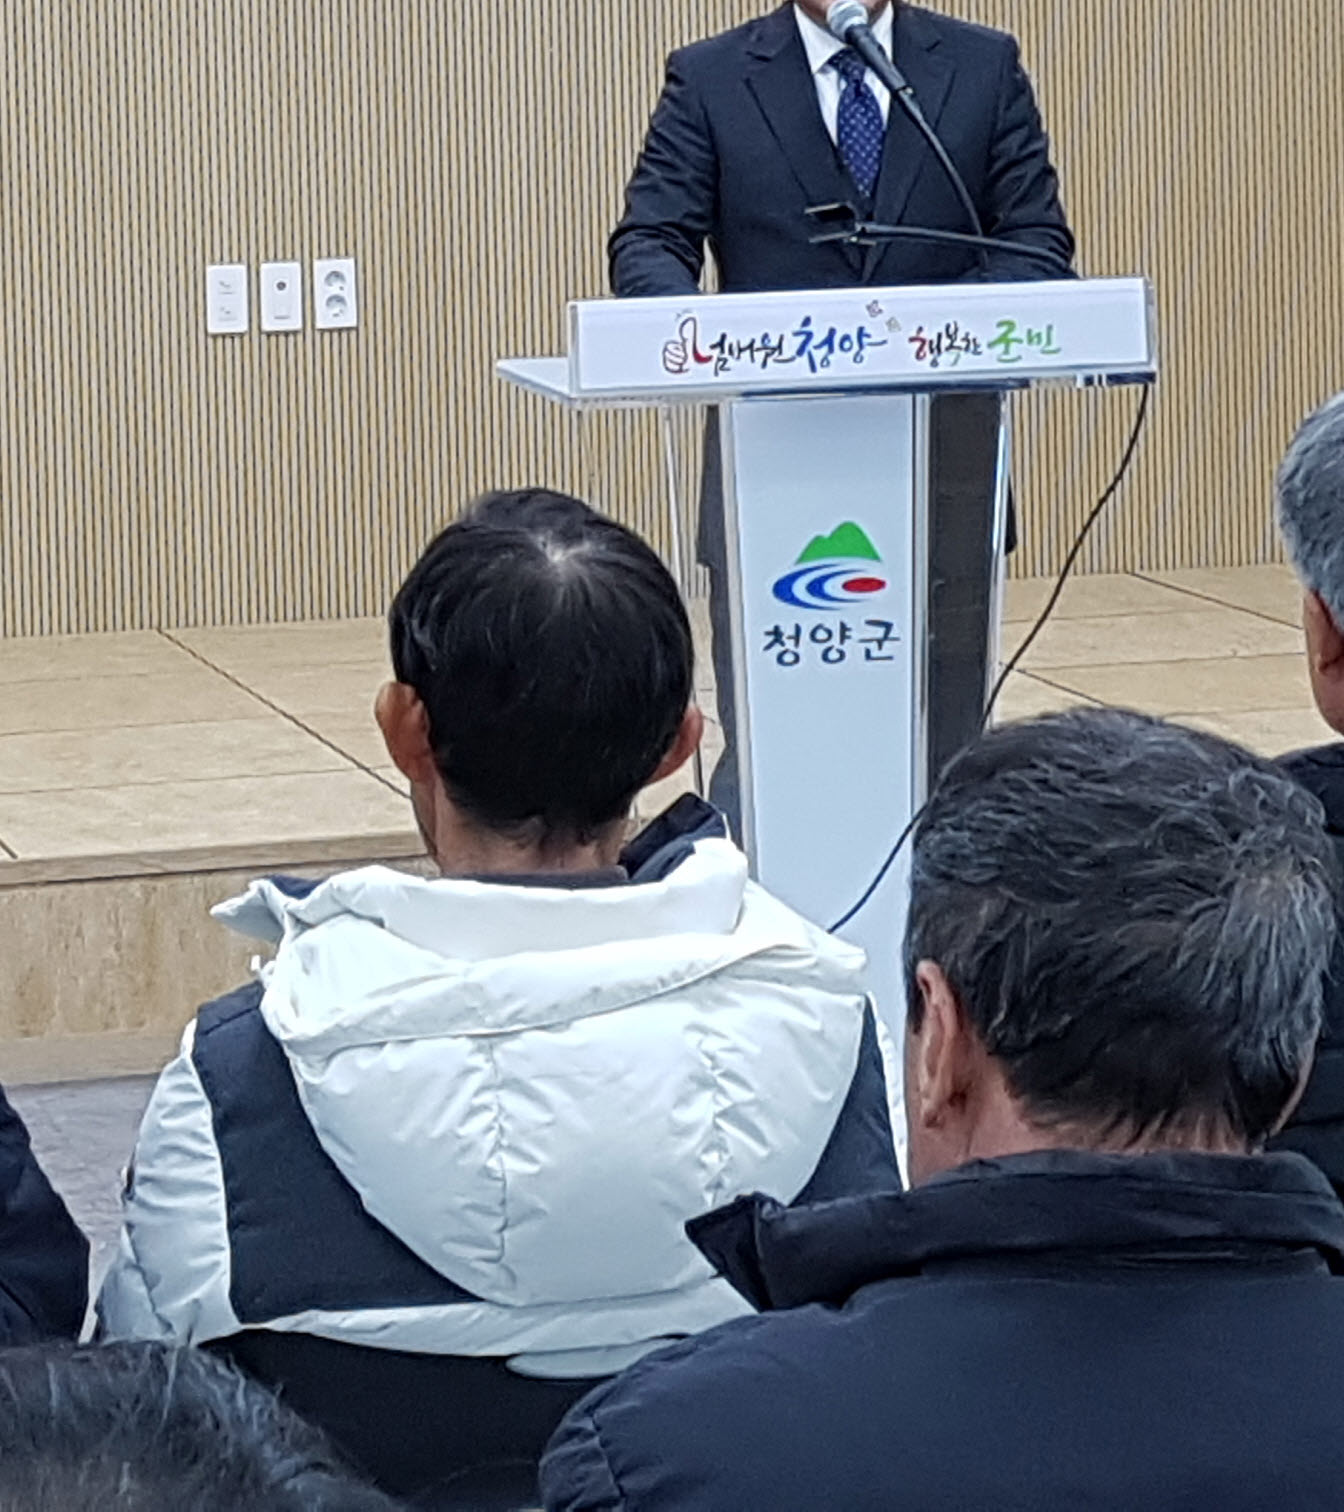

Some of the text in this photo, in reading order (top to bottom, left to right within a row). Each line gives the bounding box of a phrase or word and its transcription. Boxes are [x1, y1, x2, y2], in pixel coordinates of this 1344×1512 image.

[791, 315, 889, 373] 청양
[987, 319, 1063, 363] 군민
[762, 618, 901, 667] 청양군
